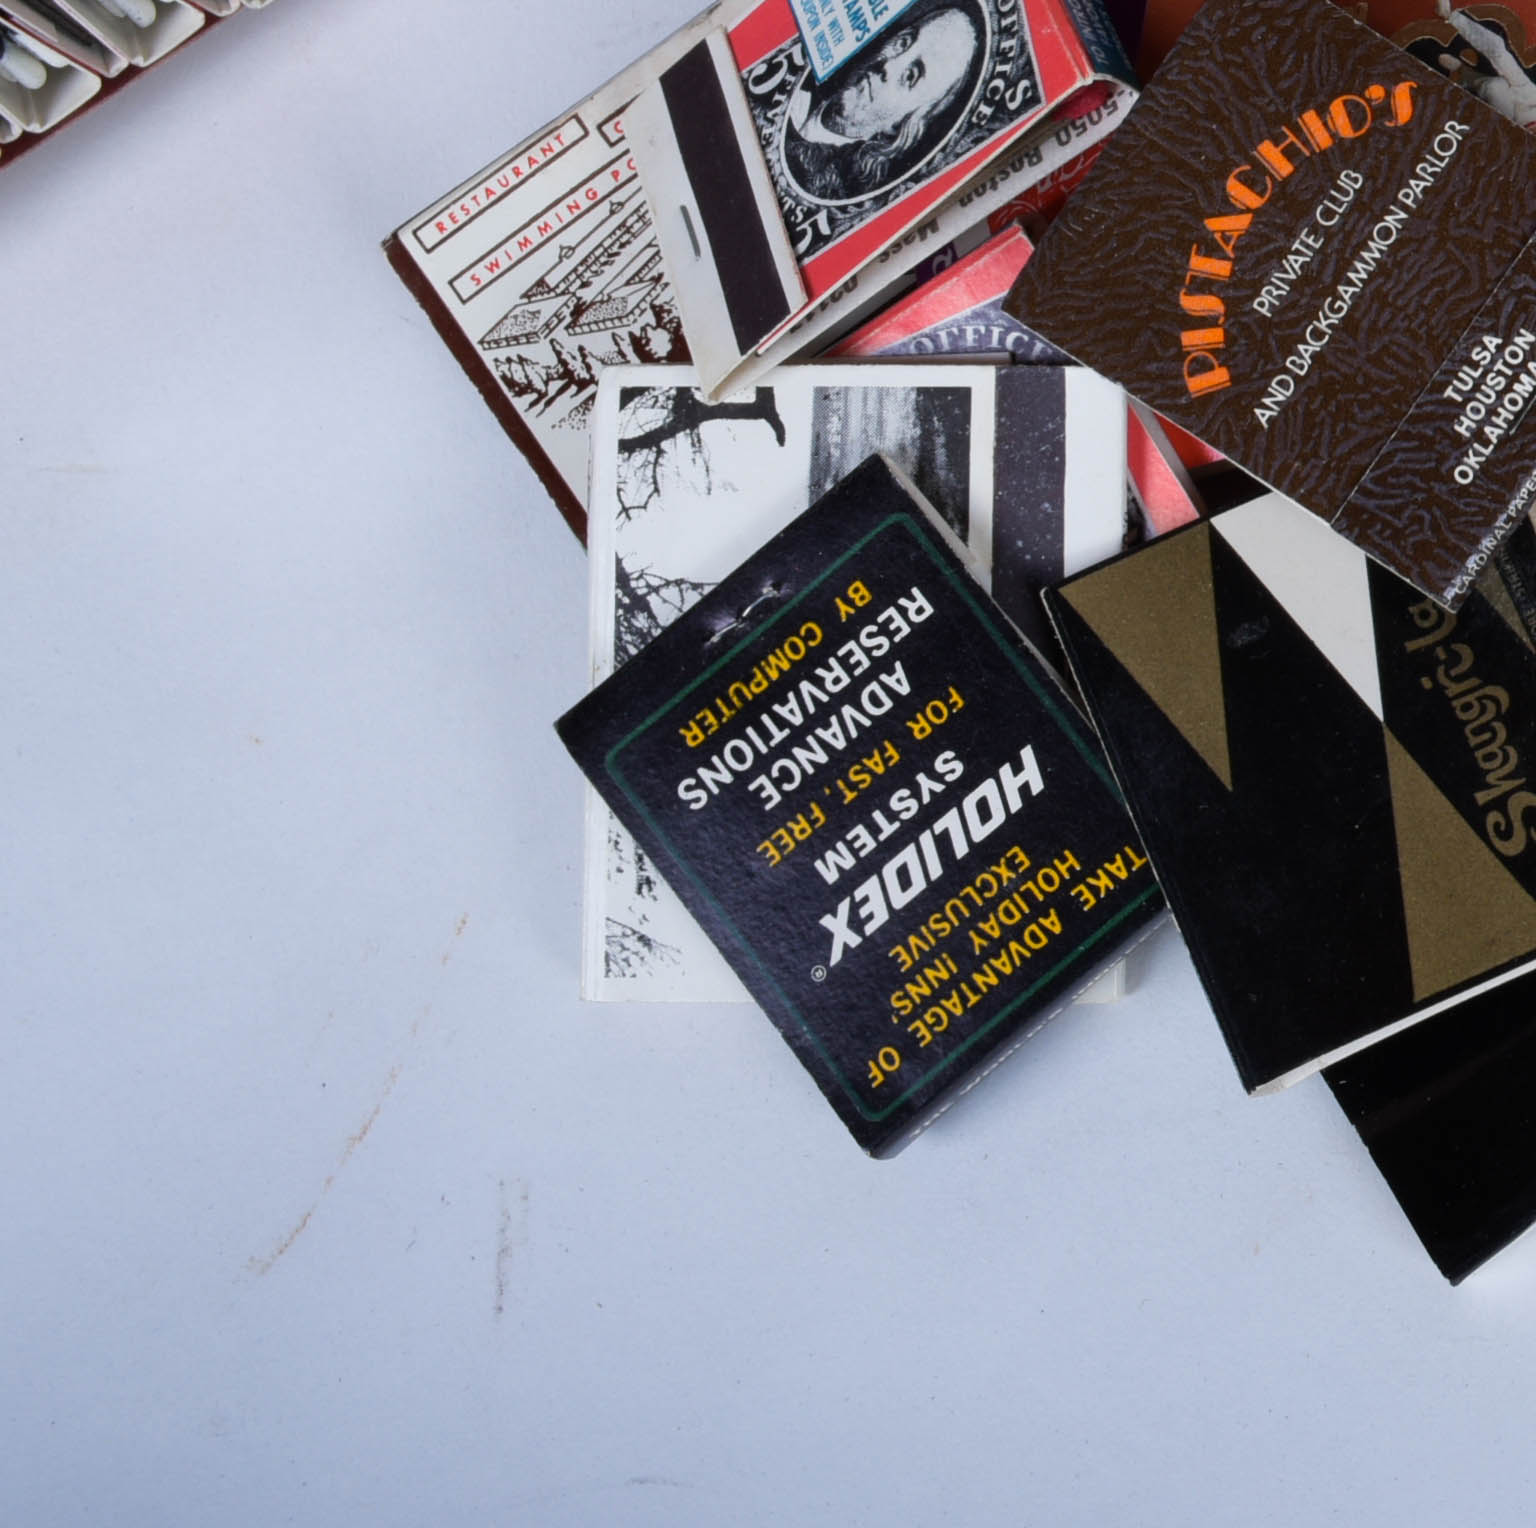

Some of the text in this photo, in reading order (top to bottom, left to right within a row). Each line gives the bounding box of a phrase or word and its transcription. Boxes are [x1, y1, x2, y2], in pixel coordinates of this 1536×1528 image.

[435, 132, 564, 234] RESTAURANT
[470, 188, 599, 287] SWIMMING
[1179, 79, 1418, 399] PISTACHIO'S
[1252, 168, 1365, 319] PRIVATE CLUB
[1252, 118, 1470, 432] AND BACKGAMMON PARLOR
[1443, 333, 1503, 404] TULSA
[1453, 328, 1536, 438] HOUSTON
[1454, 518, 1513, 595] CARDINAL
[676, 586, 934, 811] RESERVATIONS
[678, 620, 823, 748] COMPUTER
[747, 660, 912, 811] ADVANCE
[756, 686, 966, 867] FOR FREE
[813, 749, 964, 886] SYSTEM
[818, 744, 1045, 967] HOLIDEX
[887, 845, 1032, 972] EXCLUSIVE
[967, 849, 1081, 956] HOLIDAY
[866, 845, 1148, 1088] TAKE ADVANTAGE OF
